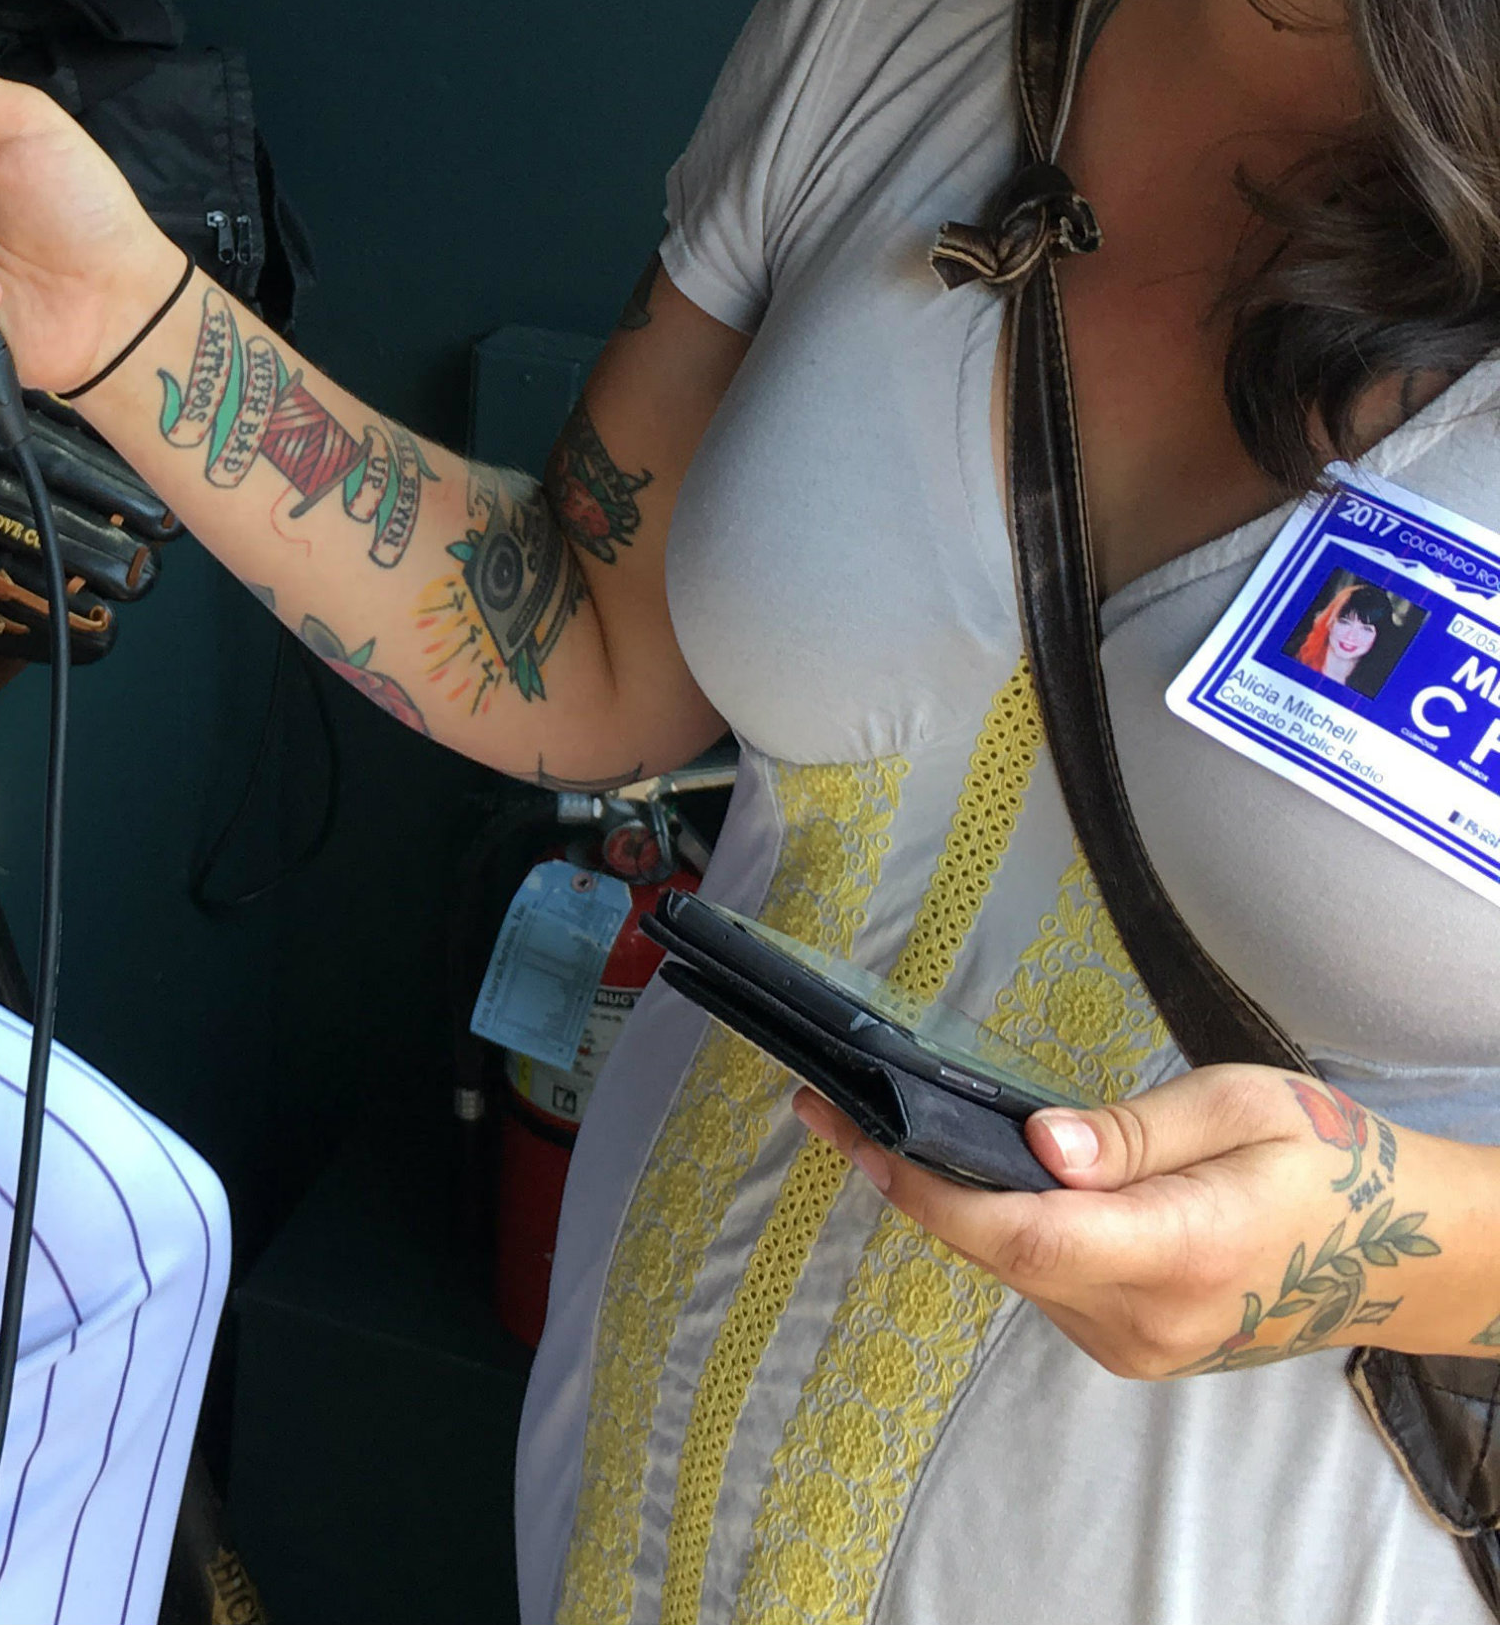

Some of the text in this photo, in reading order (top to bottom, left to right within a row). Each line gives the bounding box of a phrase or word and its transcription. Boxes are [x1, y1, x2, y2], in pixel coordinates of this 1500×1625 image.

[186, 312, 226, 423] TATTOOS
[223, 349, 274, 473] WITH BAD
[368, 455, 387, 490] UP
[1337, 499, 1401, 538] 2017
[1399, 530, 1477, 575] COLORADO
[1219, 685, 1384, 784] Colorado Public Radio
[1226, 668, 1358, 746] Alicia Mitchell
[1410, 685, 1467, 739] C
